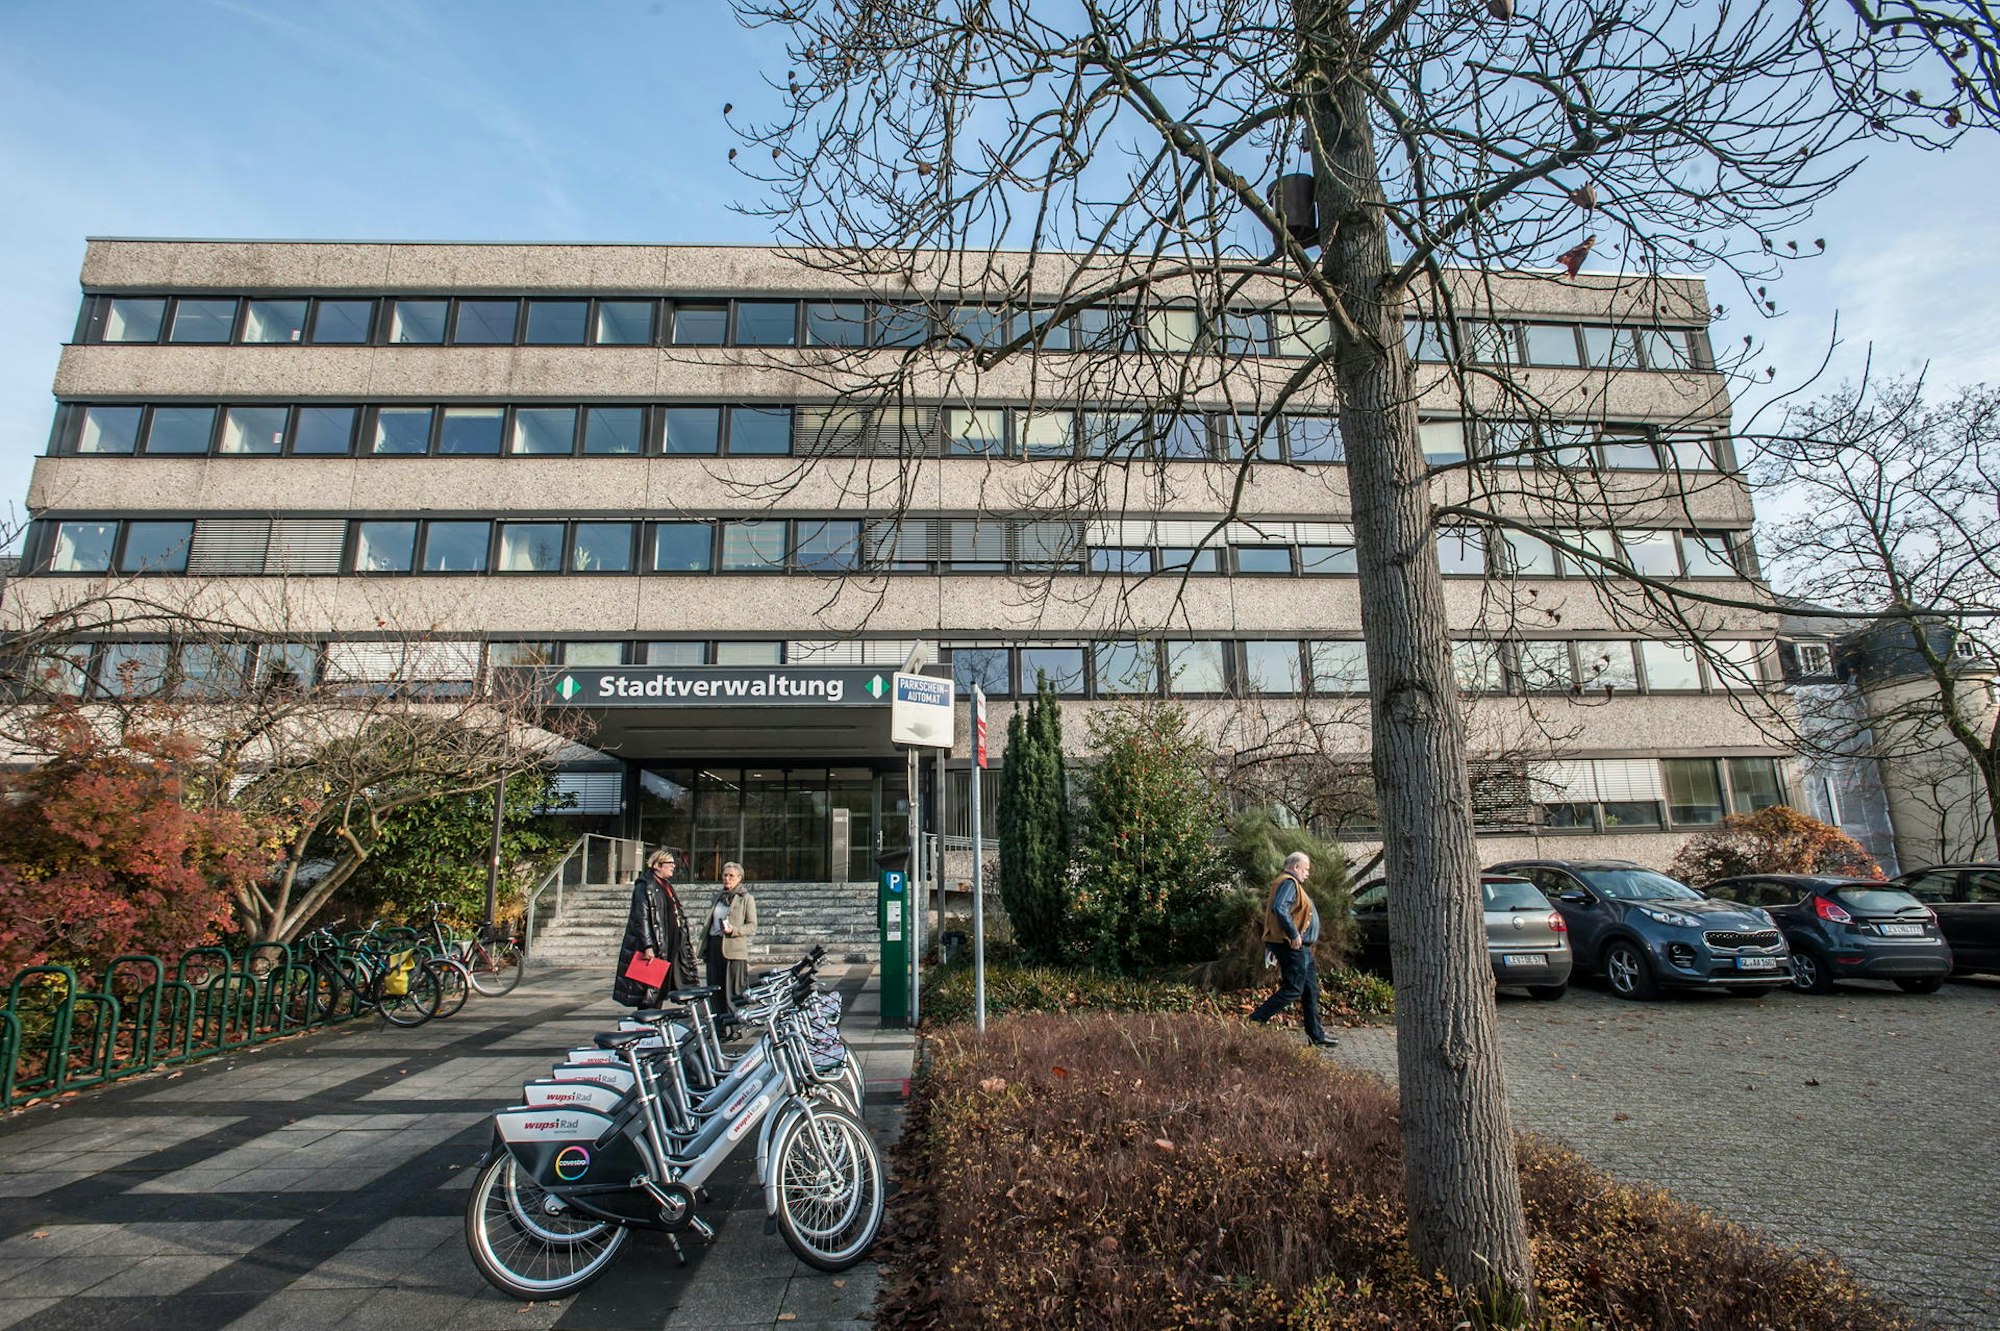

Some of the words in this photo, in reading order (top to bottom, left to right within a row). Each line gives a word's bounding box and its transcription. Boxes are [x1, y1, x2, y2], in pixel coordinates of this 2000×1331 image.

[599, 674, 844, 701] Stadtverwaltung
[900, 679, 949, 694] PARKSCHEIN-
[907, 691, 941, 704] AUTOMAT
[890, 873, 900, 889] P
[559, 1159, 587, 1167] covestro
